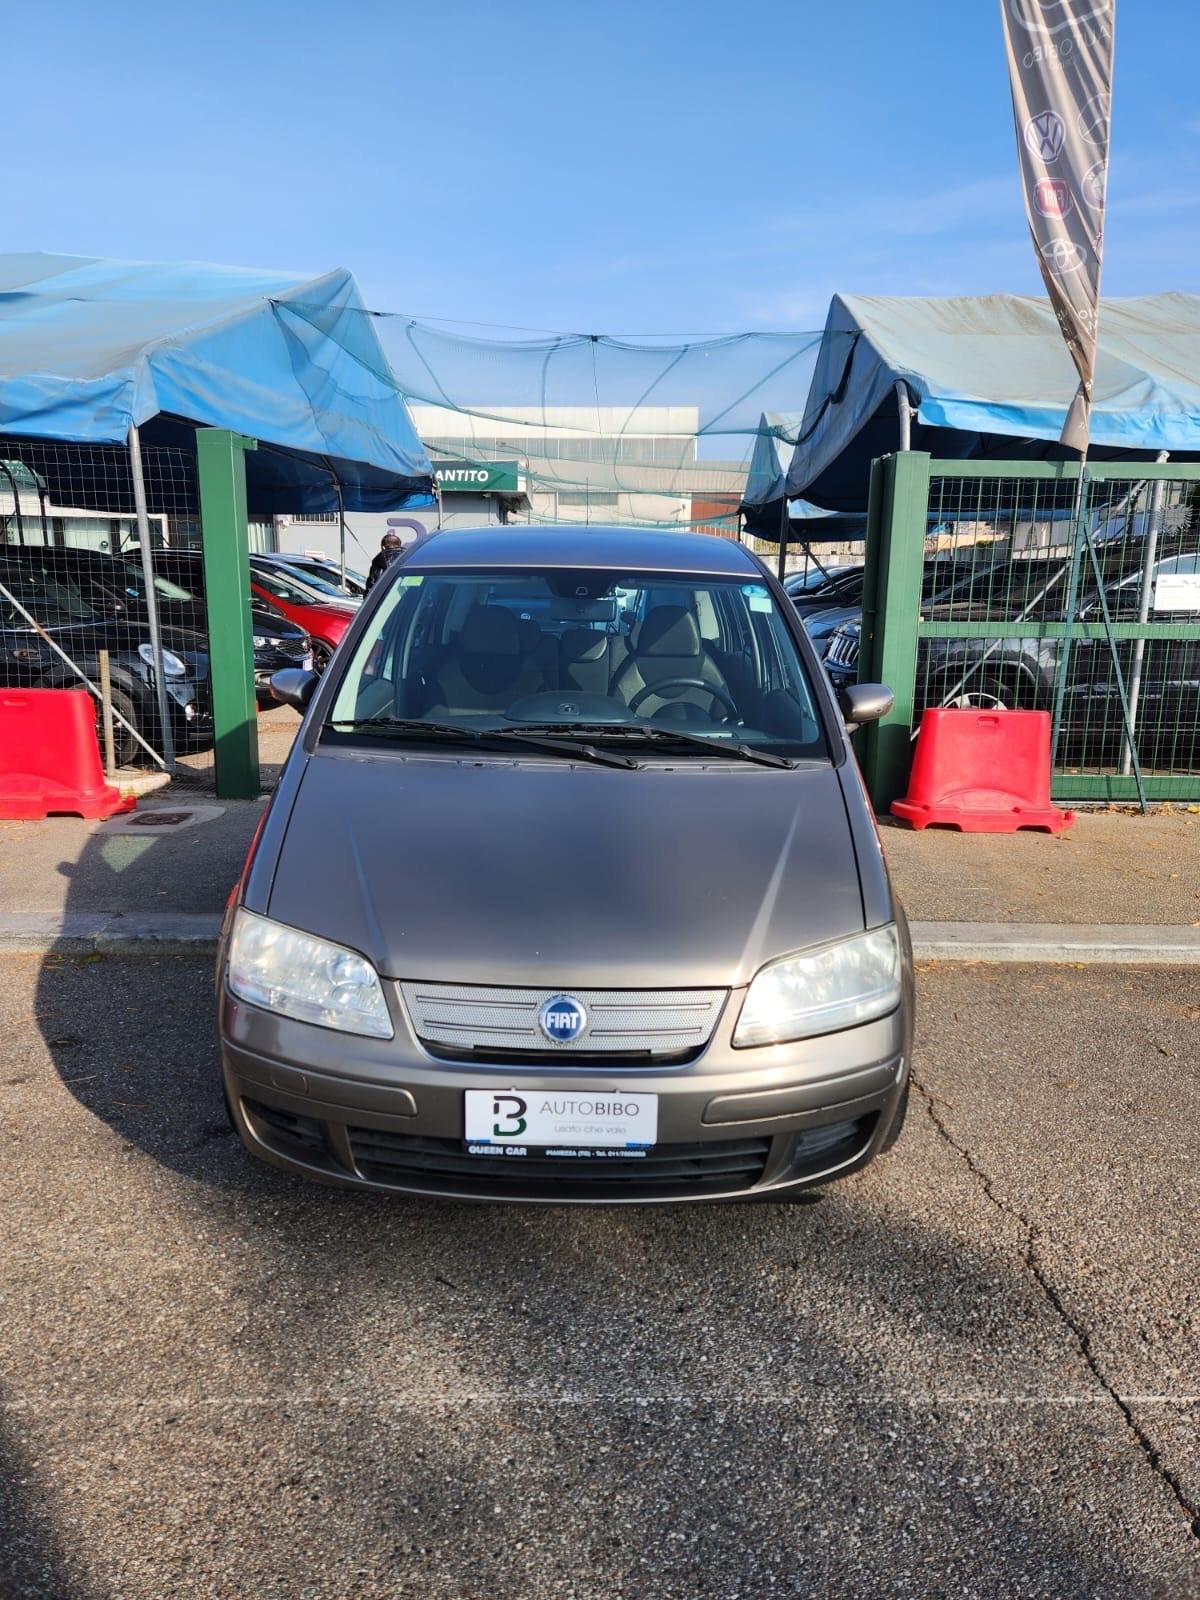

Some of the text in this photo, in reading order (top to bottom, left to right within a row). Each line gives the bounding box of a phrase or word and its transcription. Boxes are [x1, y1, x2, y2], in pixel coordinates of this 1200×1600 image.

[547, 1012, 579, 1029] FIAT
[539, 1100, 640, 1117] AUTOBIBO
[584, 1123, 603, 1135] che
[468, 1145, 527, 1157] QUEEN CAR
